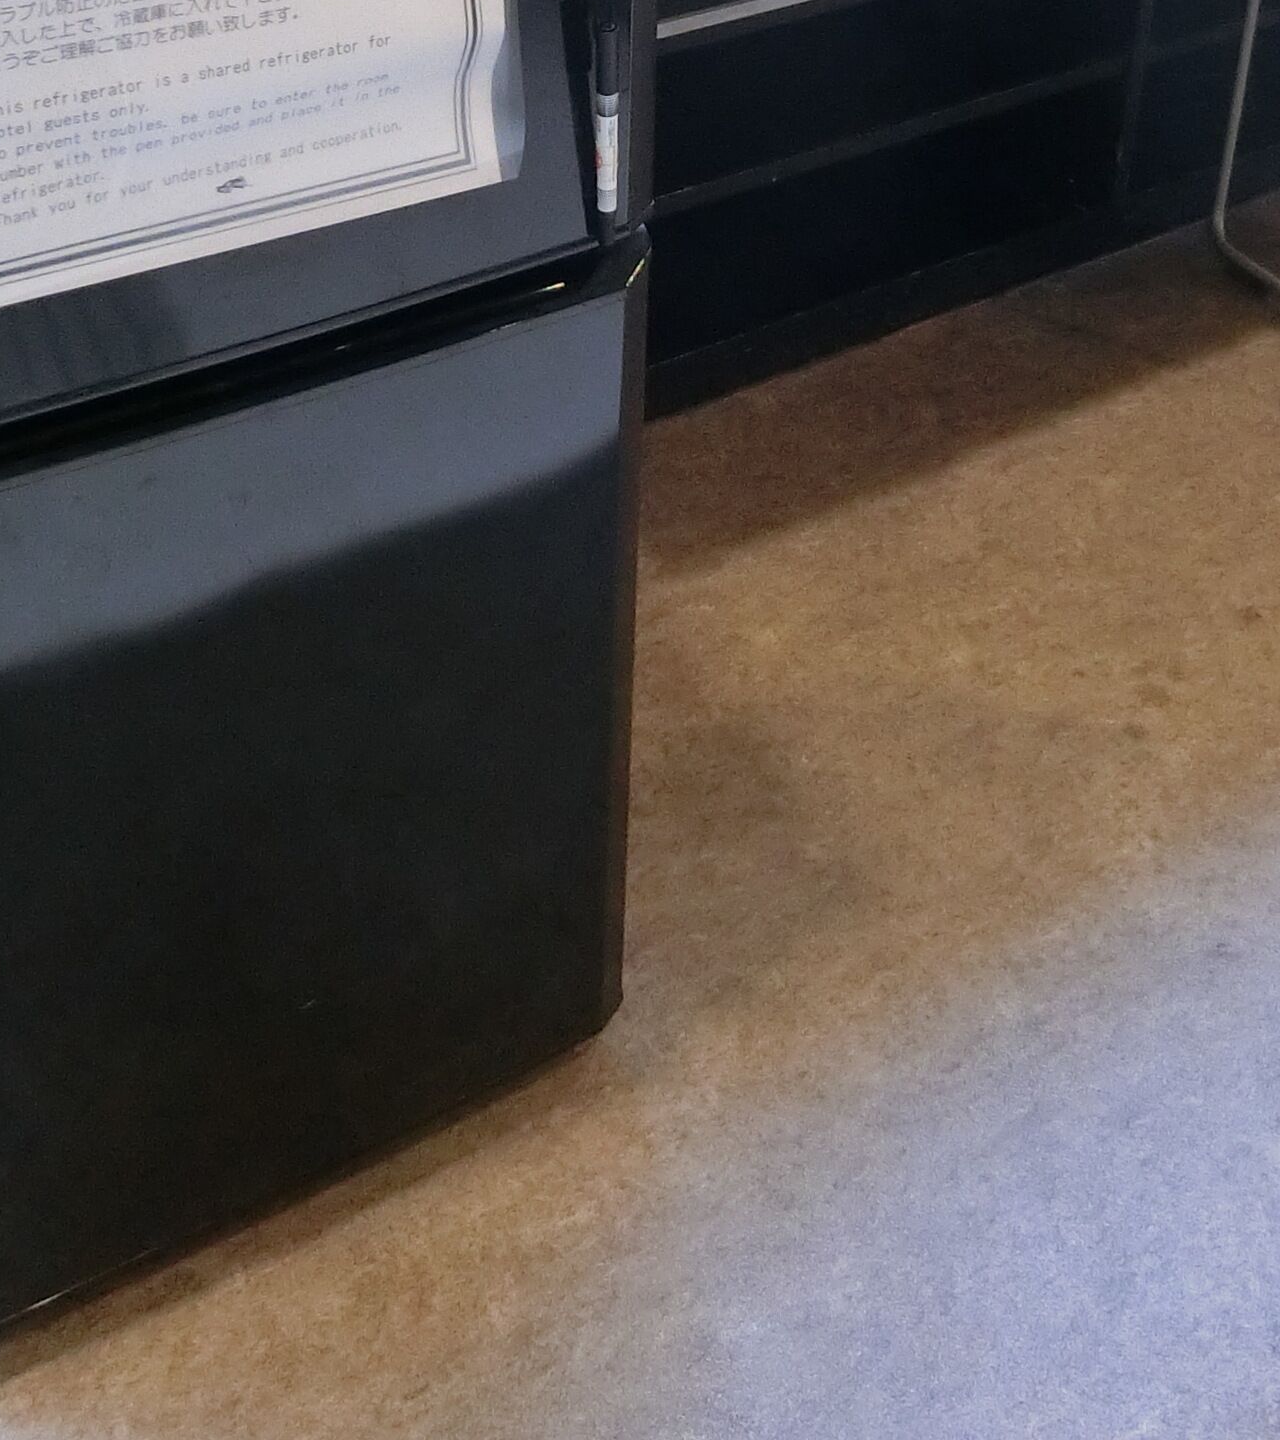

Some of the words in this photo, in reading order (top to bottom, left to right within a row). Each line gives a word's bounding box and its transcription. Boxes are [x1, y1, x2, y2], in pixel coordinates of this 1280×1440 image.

[33, 80, 143, 110] refrigerator
[155, 74, 171, 88] is
[181, 73, 190, 84] a
[199, 60, 250, 81] shared
[259, 41, 359, 68] refrigerator
[369, 34, 392, 49] for
[16, 133, 81, 158] prevent
[181, 111, 198, 125] be
[208, 104, 242, 120] sure
[252, 96, 267, 110] to
[275, 87, 316, 105] enter
[325, 79, 349, 95] the
[357, 73, 390, 87] room
[44, 110, 100, 132] guests
[109, 102, 150, 119] only.
[54, 152, 91, 170] with
[102, 145, 128, 159] the
[135, 137, 164, 153] pen
[171, 120, 240, 147] provided
[248, 113, 273, 128] and
[280, 103, 322, 122] place
[331, 97, 345, 110] it
[355, 92, 370, 103] in
[377, 84, 401, 98] the
[48, 200, 76, 215] you
[85, 189, 110, 204] for
[120, 179, 154, 198] your
[162, 152, 272, 187] understanding
[280, 143, 305, 158] and
